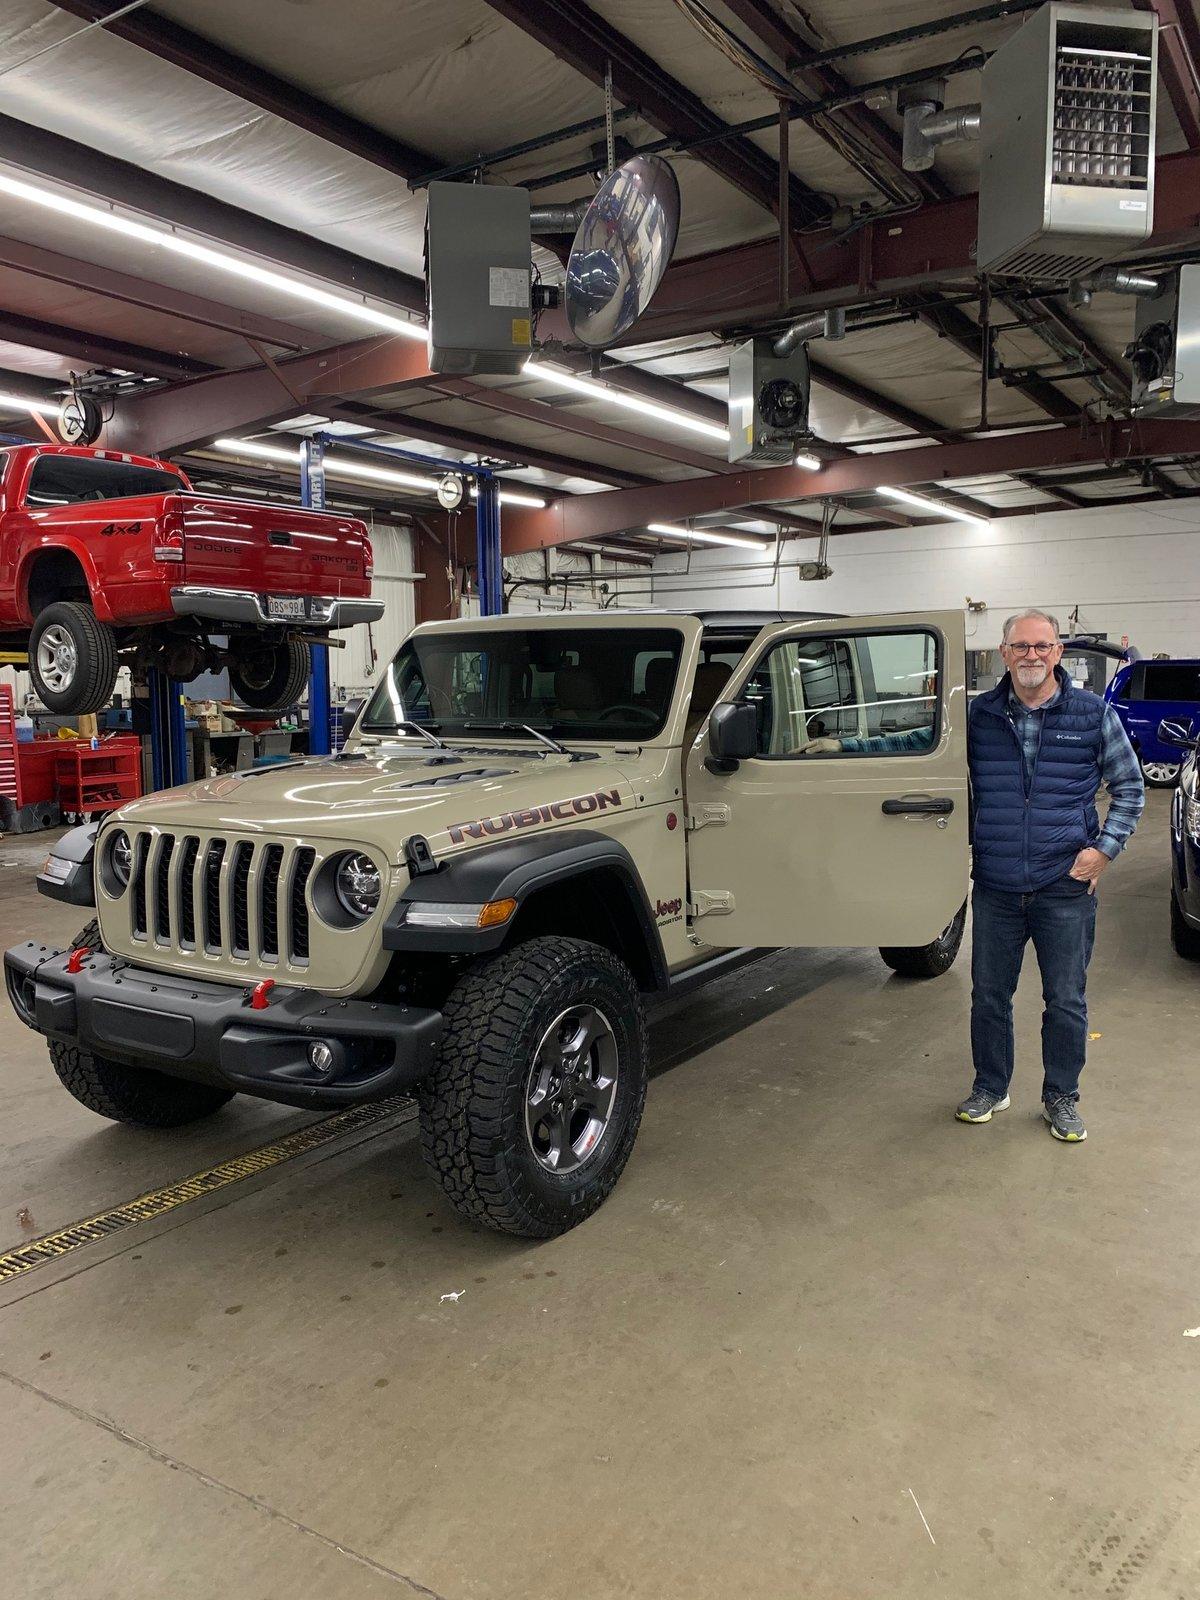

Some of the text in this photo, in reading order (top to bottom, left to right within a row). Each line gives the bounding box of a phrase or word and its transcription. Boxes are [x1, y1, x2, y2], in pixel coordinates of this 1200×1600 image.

[310, 474, 322, 510] TARY
[101, 521, 143, 536] 4x4
[194, 544, 242, 554] DODGE
[311, 554, 358, 564] DAKOTA
[447, 789, 622, 844] RUBICON
[654, 897, 682, 919] Jeep
